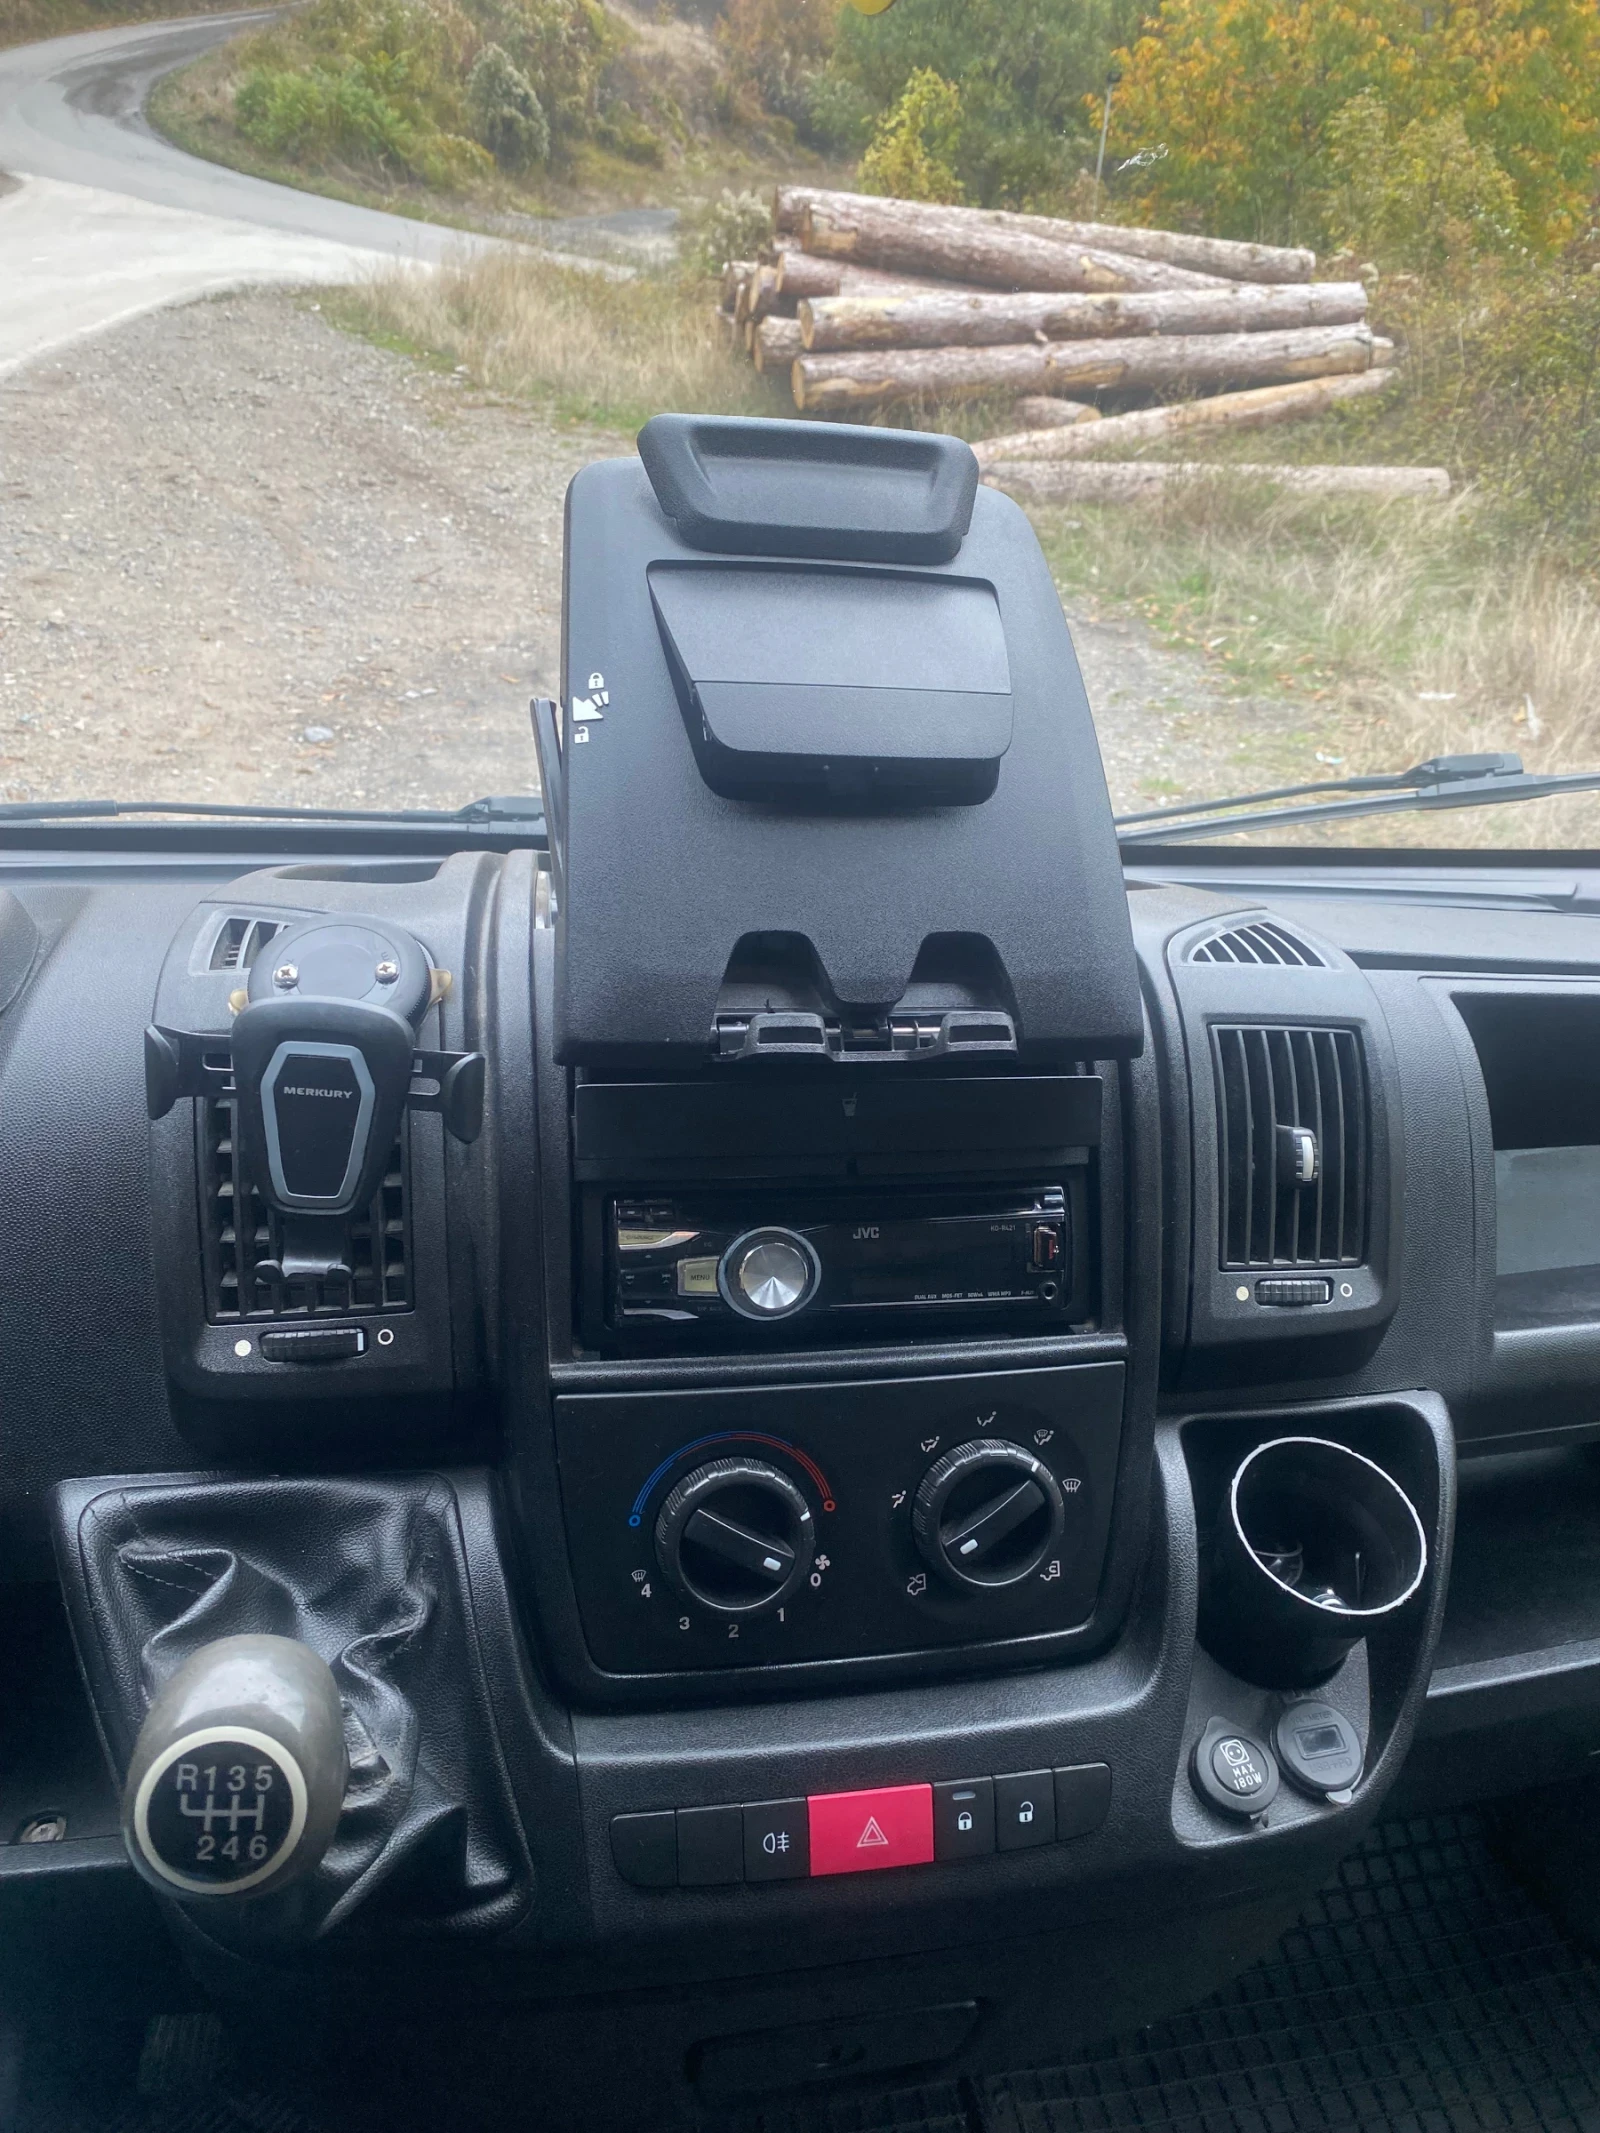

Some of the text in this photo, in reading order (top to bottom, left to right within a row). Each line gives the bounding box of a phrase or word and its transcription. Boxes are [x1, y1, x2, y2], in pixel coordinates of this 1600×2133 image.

[283, 1086, 353, 1099] MERKURY
[853, 1227, 880, 1239] JVC
[641, 1583, 652, 1598] 4
[776, 1607, 786, 1622] 1
[679, 1616, 690, 1630] 3
[728, 1624, 740, 1638] 2
[1232, 1763, 1255, 1777] MAX
[1233, 1771, 1262, 1790] 180W
